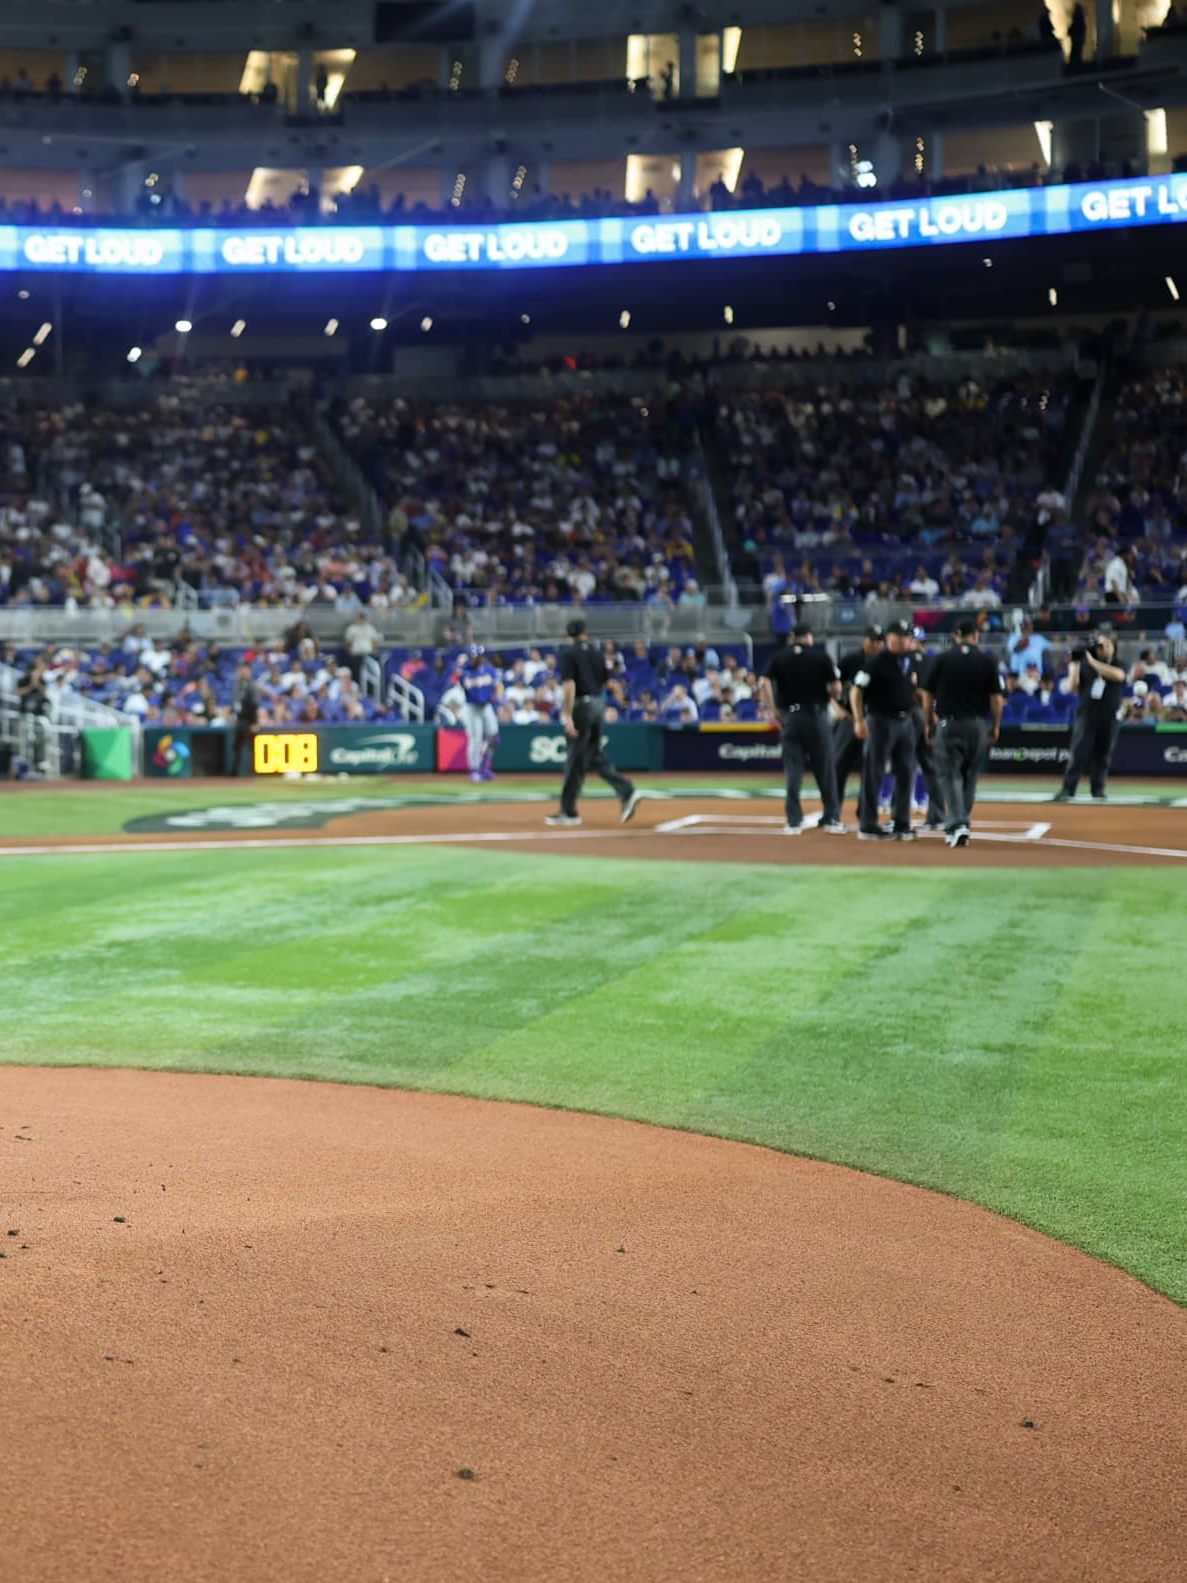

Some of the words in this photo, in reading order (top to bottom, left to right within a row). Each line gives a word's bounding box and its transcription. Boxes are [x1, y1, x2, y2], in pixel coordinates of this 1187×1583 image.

[849, 208, 916, 240] GET
[920, 199, 1009, 236] LOUD
[1081, 186, 1153, 222] GET
[24, 231, 84, 262] GET
[86, 235, 165, 265] LOUD
[221, 235, 284, 264] GET
[284, 234, 365, 263] LOUD
[424, 233, 485, 262] GET
[487, 229, 569, 260] LOUD
[631, 222, 695, 253] GET
[698, 216, 782, 249] LOUD
